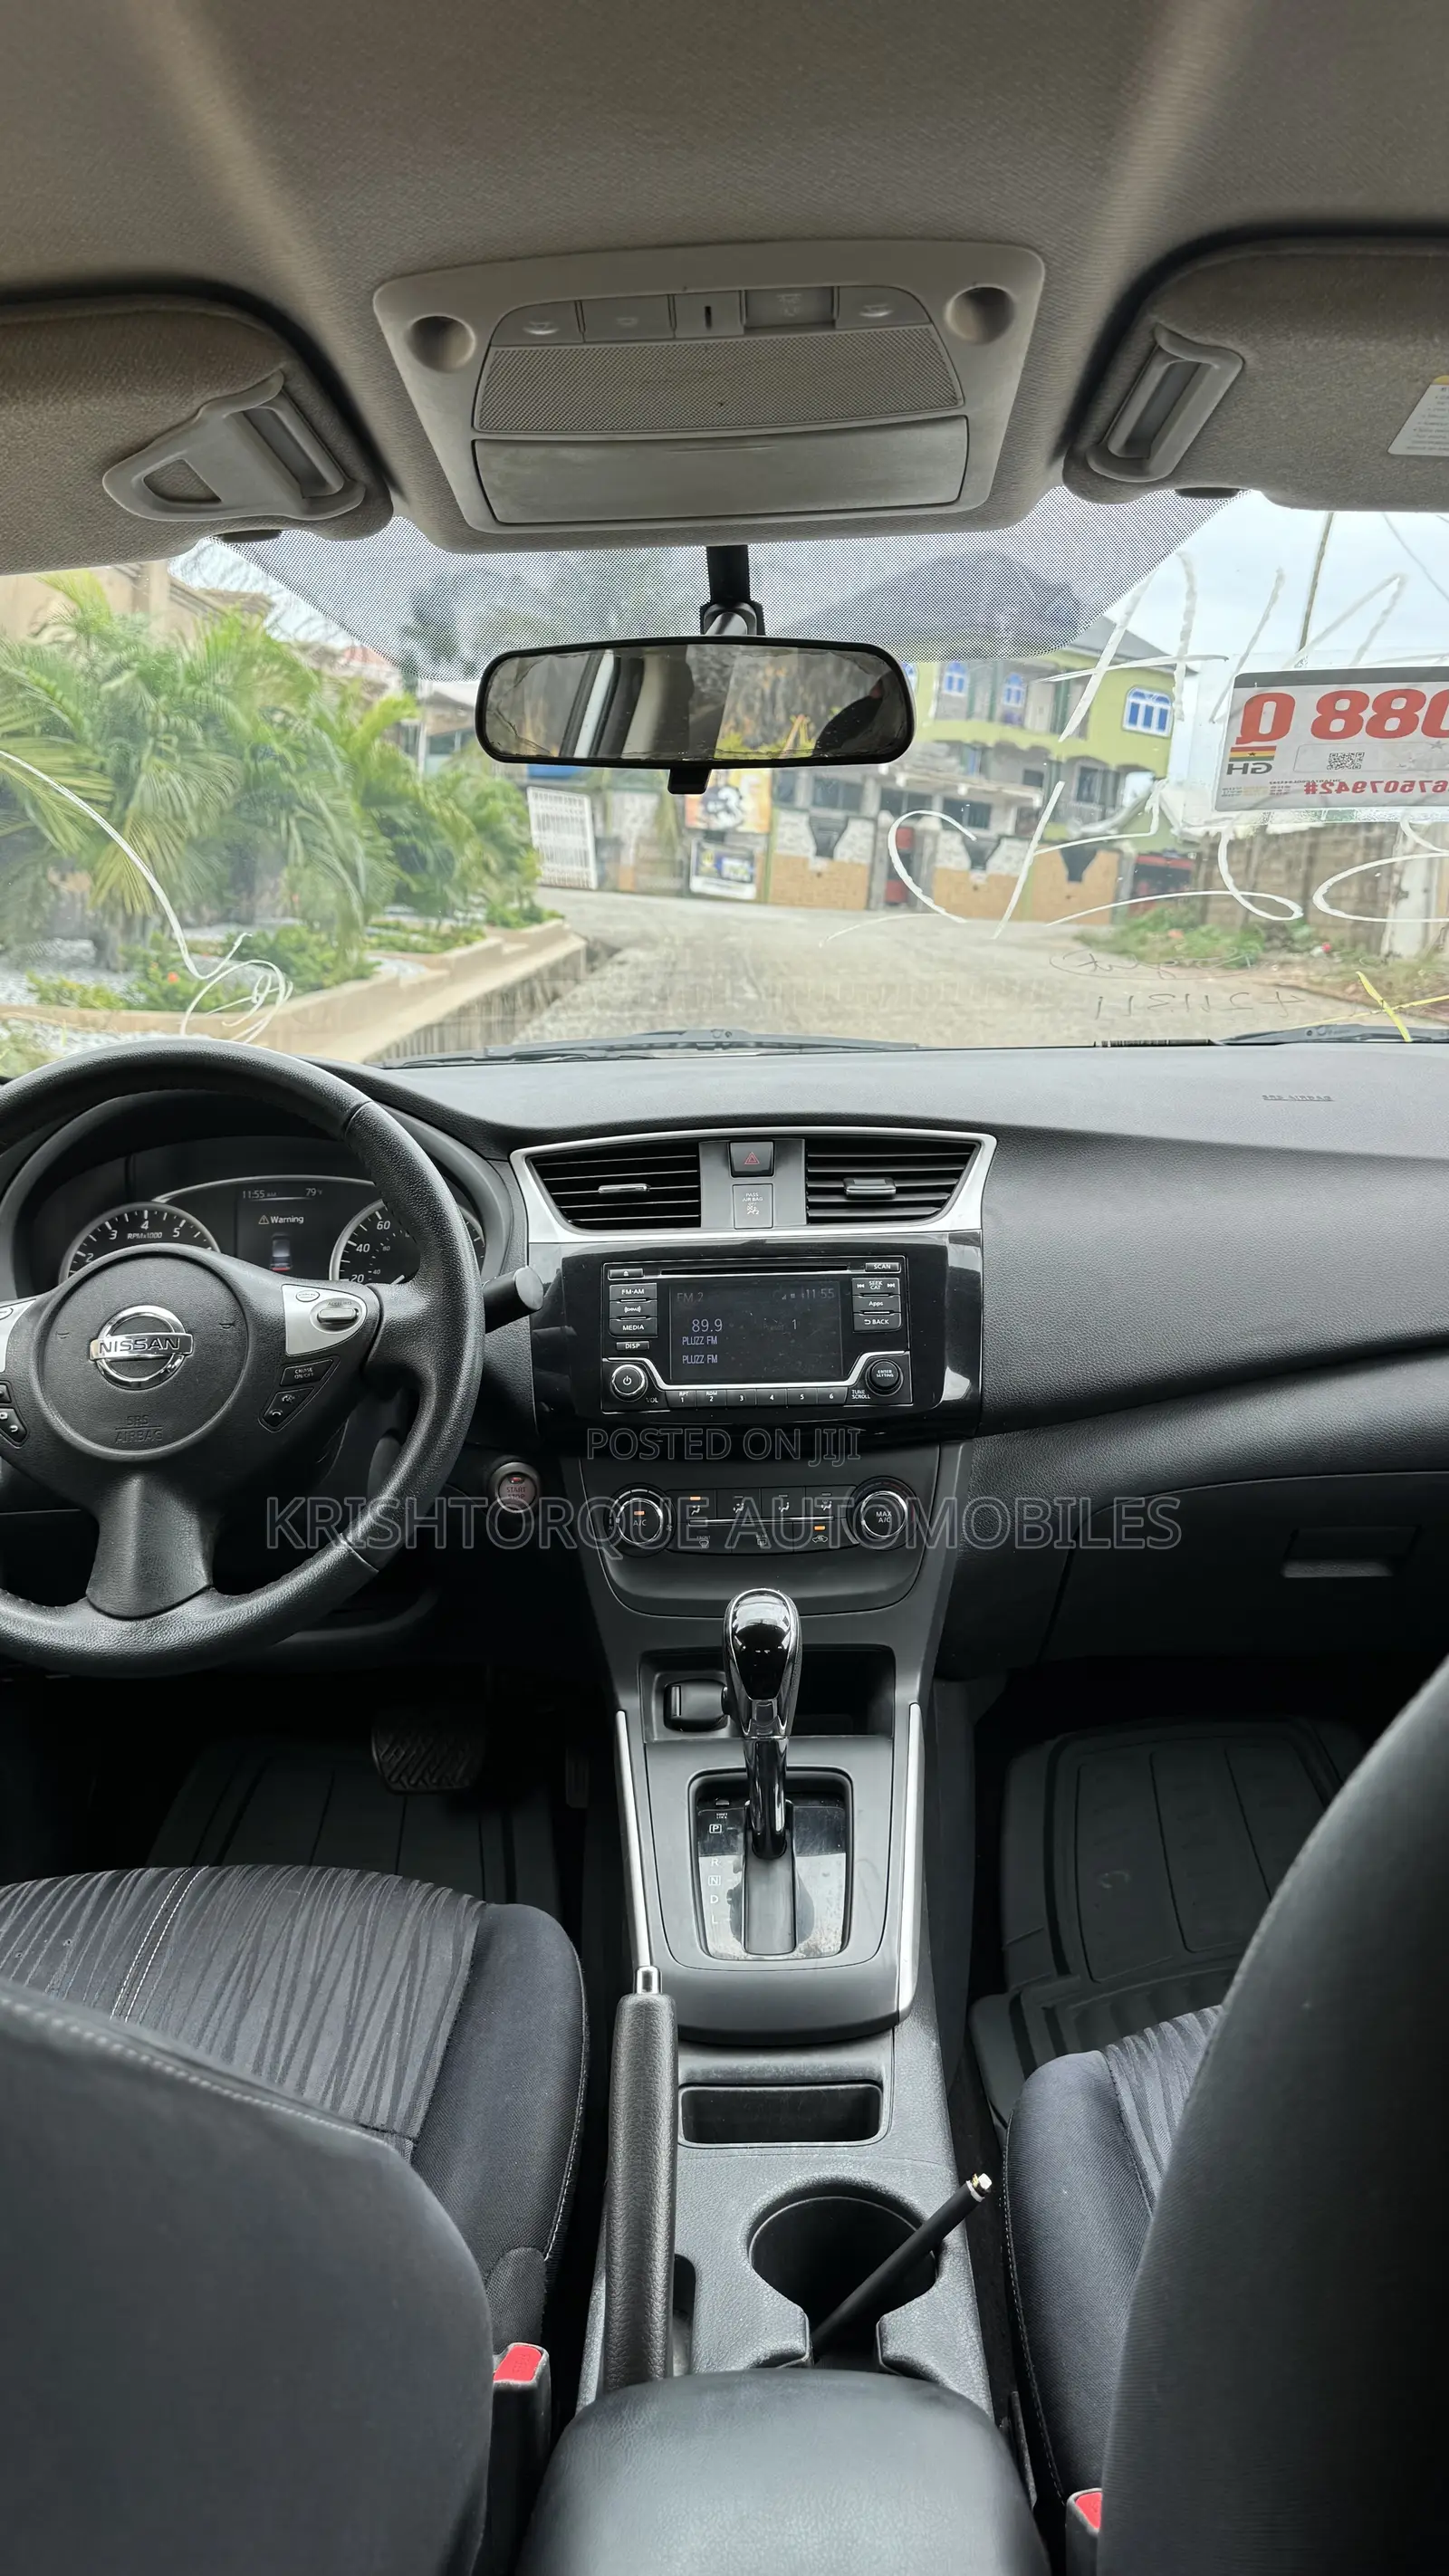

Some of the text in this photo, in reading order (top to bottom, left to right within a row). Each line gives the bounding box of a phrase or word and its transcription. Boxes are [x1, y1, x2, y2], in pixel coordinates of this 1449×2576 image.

[243, 1190, 265, 1199] 11:55
[270, 1214, 303, 1225] Warning
[140, 1221, 149, 1231] 4
[376, 1221, 390, 1231] 60
[109, 1230, 118, 1240] 3
[172, 1228, 180, 1238] 5
[356, 1243, 370, 1253] 40
[85, 1253, 93, 1262] 2
[350, 1274, 365, 1283] 20
[691, 1318, 723, 1333] 89.9
[792, 1318, 797, 1330] 1
[682, 1336, 718, 1345] PLUZZ FM
[99, 1337, 180, 1355] NISSAN
[682, 1355, 718, 1365] PLUZZ FM
[632, 1518, 648, 1527] A/C
[711, 1858, 719, 1866] R
[710, 1894, 718, 1903] D
[712, 1915, 718, 1924] L
